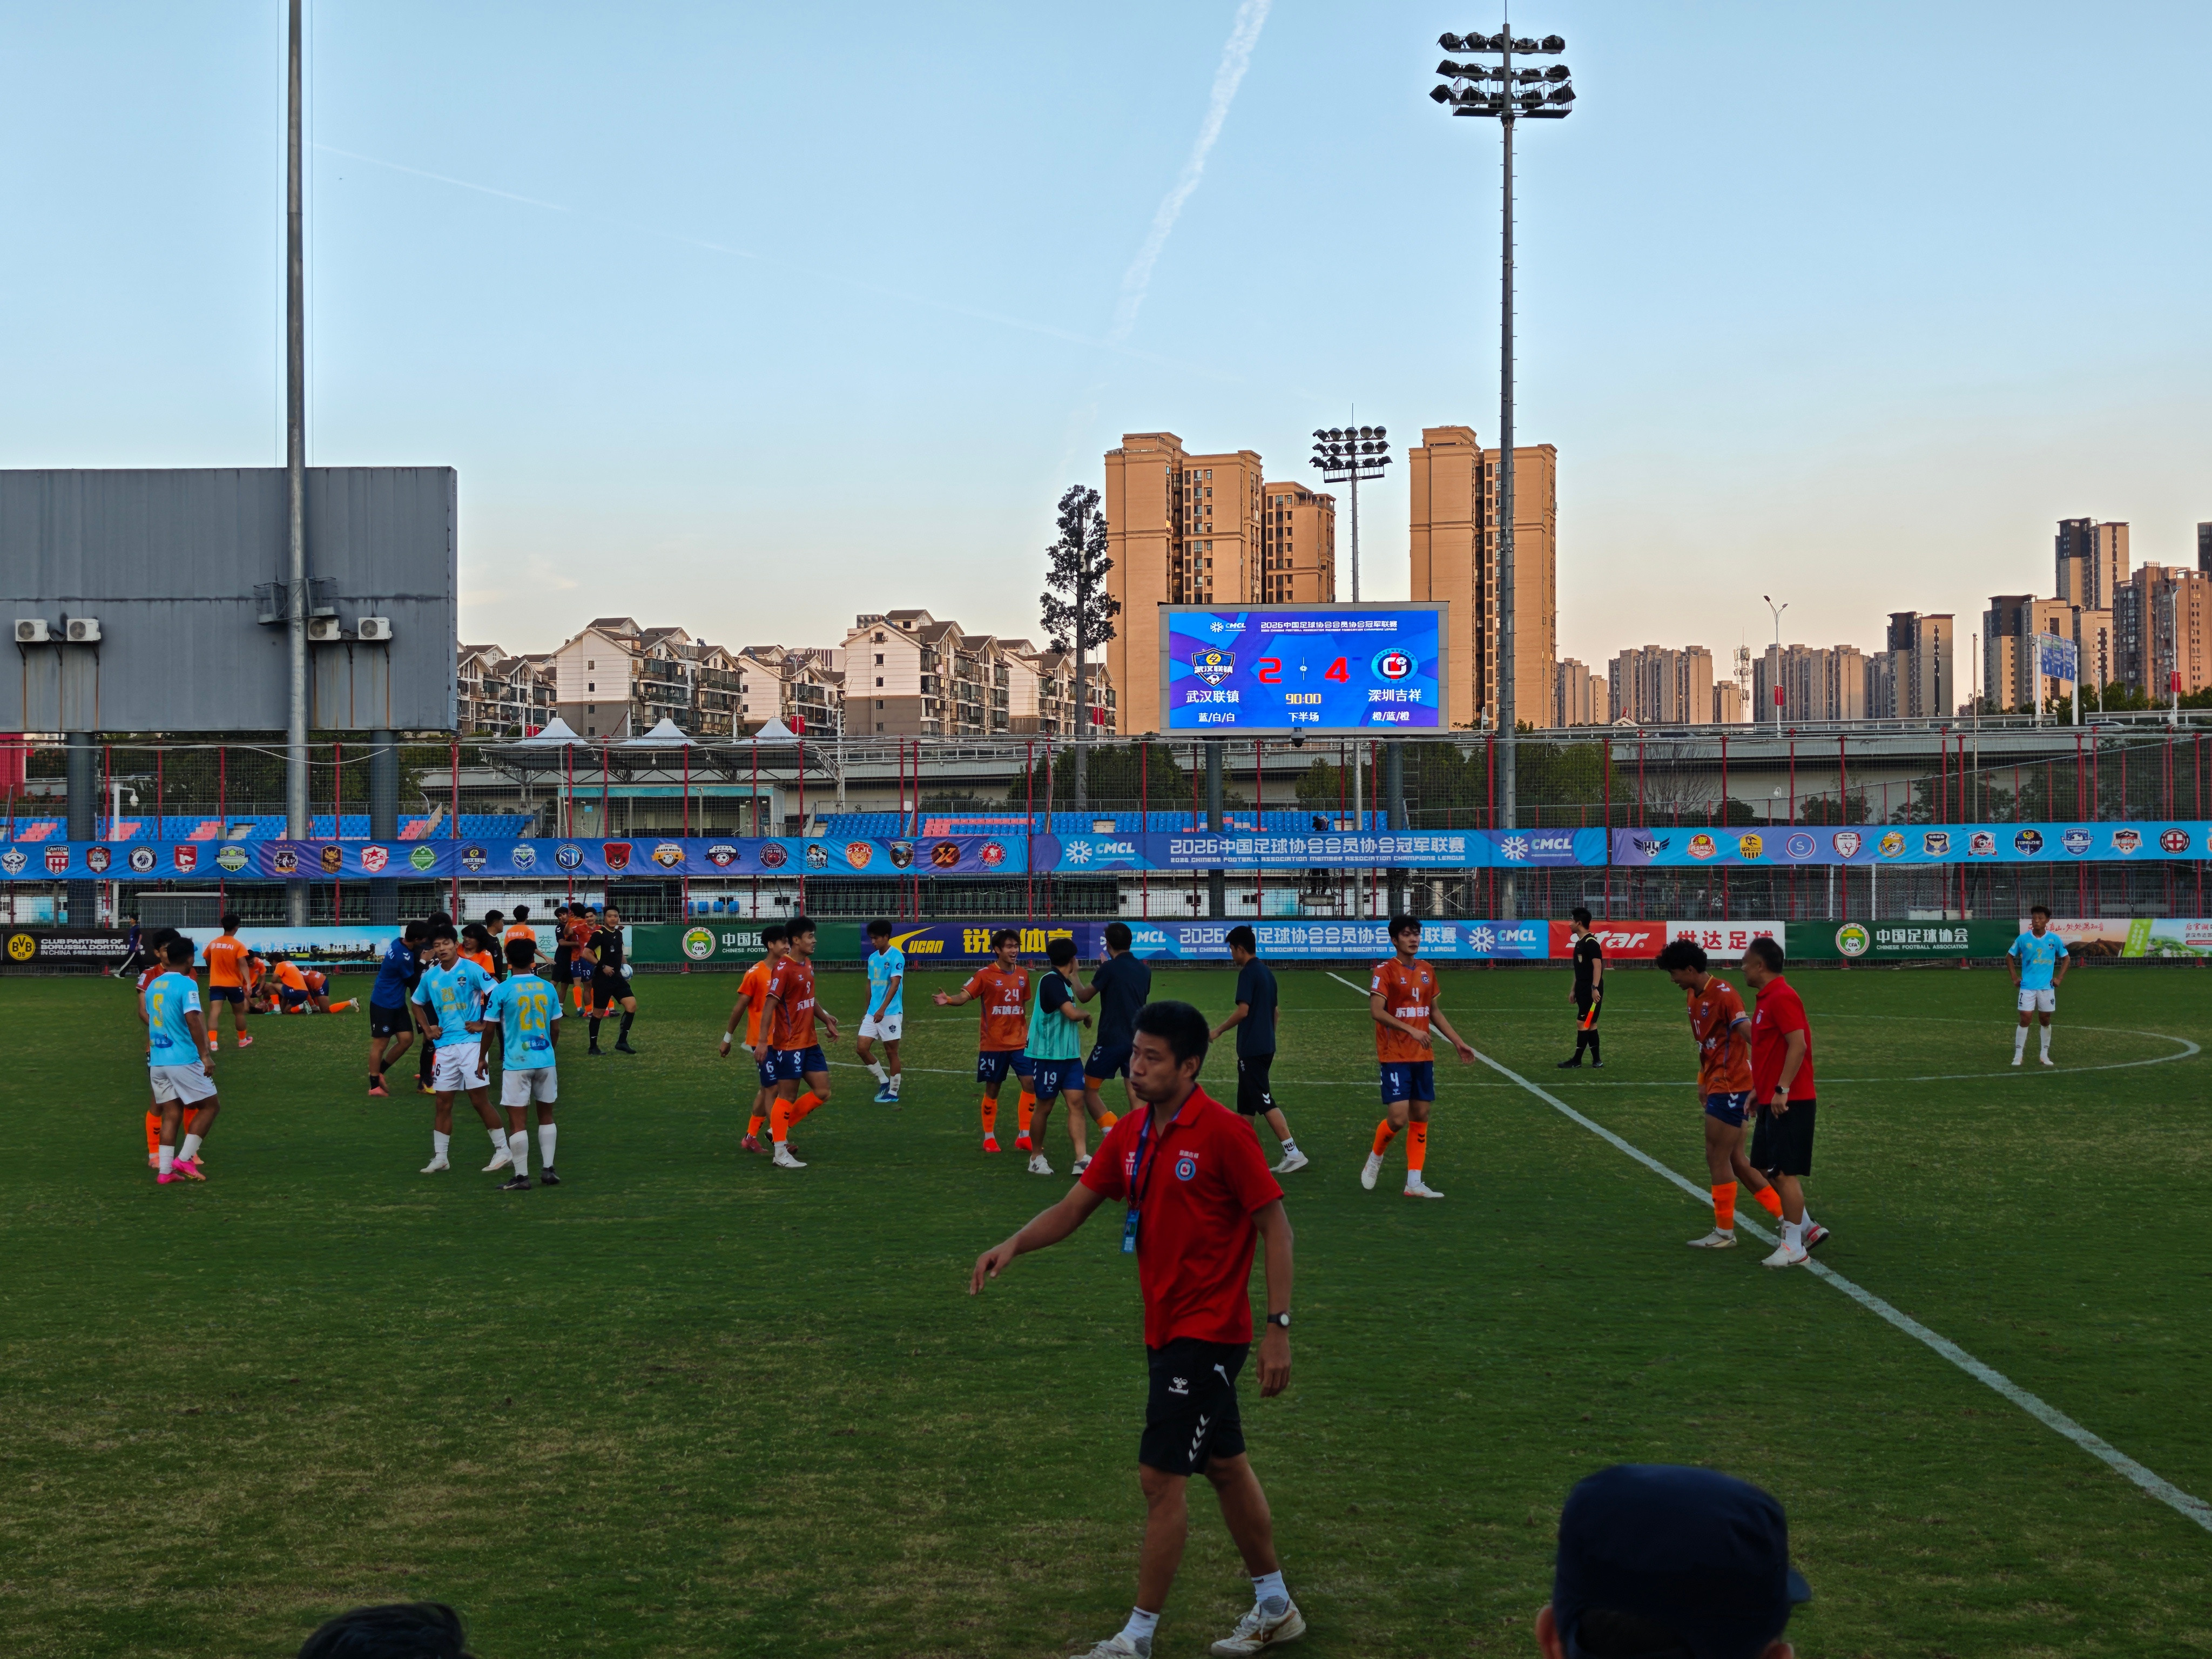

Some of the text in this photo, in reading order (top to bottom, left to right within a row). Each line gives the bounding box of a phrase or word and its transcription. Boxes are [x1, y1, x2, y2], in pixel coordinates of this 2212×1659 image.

[1258, 657, 1350, 684] 2 4
[1186, 690, 1239, 703] 武汉联镇
[1285, 693, 1321, 705] 90:00
[1367, 689, 1422, 702] 深圳吉祥
[1198, 712, 1235, 723] 蓝/白/白
[1288, 711, 1319, 722] 下半场
[1372, 711, 1410, 721] 橙/蓝/橙
[1095, 841, 1135, 854] CMCL
[1170, 837, 1465, 854] 2026中国足球协会会员协会冠军联赛
[1531, 838, 1572, 850] CMCL
[722, 932, 764, 947] 中国足
[963, 928, 1073, 953] 锐体
[1179, 927, 1456, 944] 2026足球协会会员协会联赛
[1498, 929, 1536, 941] CMCL
[1876, 928, 1968, 943] 中国足球协会
[12, 937, 32, 952] BVB
[1004, 989, 1020, 1002] 24
[1412, 987, 1419, 1002] 4
[517, 994, 548, 1030] 25
[793, 1051, 801, 1064] 8
[766, 1061, 774, 1073] 6
[980, 1058, 995, 1071] 24
[1043, 1071, 1057, 1085] 19
[1390, 1071, 1400, 1087] 4
